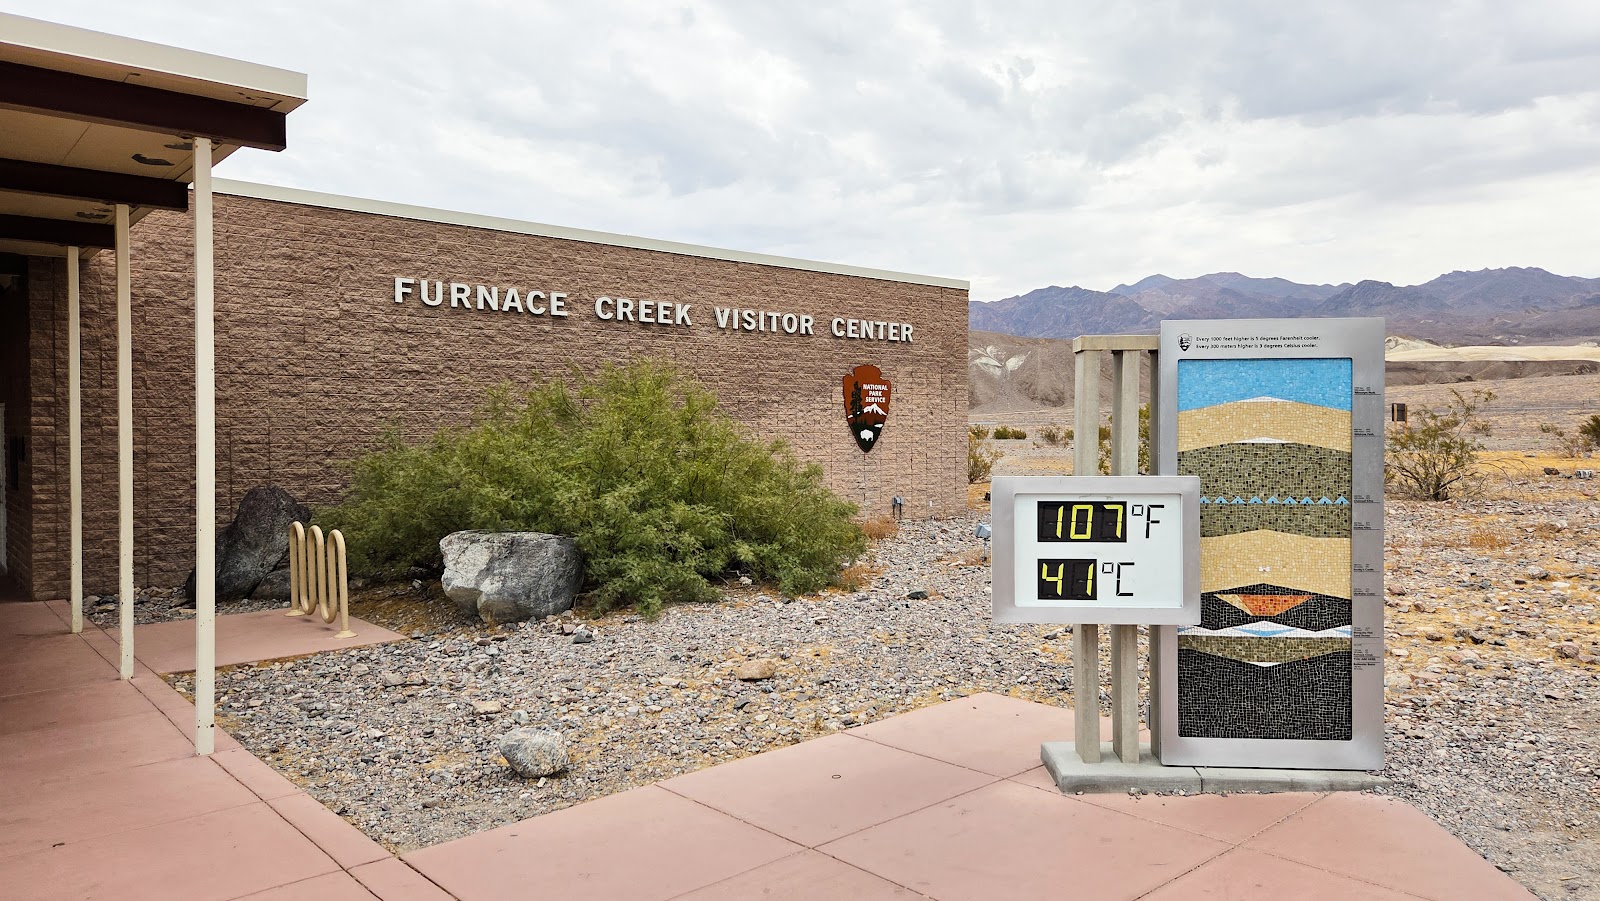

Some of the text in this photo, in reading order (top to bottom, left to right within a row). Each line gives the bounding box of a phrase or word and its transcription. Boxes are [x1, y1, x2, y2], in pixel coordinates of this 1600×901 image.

[393, 276, 915, 343] FURNACE CREEK VISITOR CENTER
